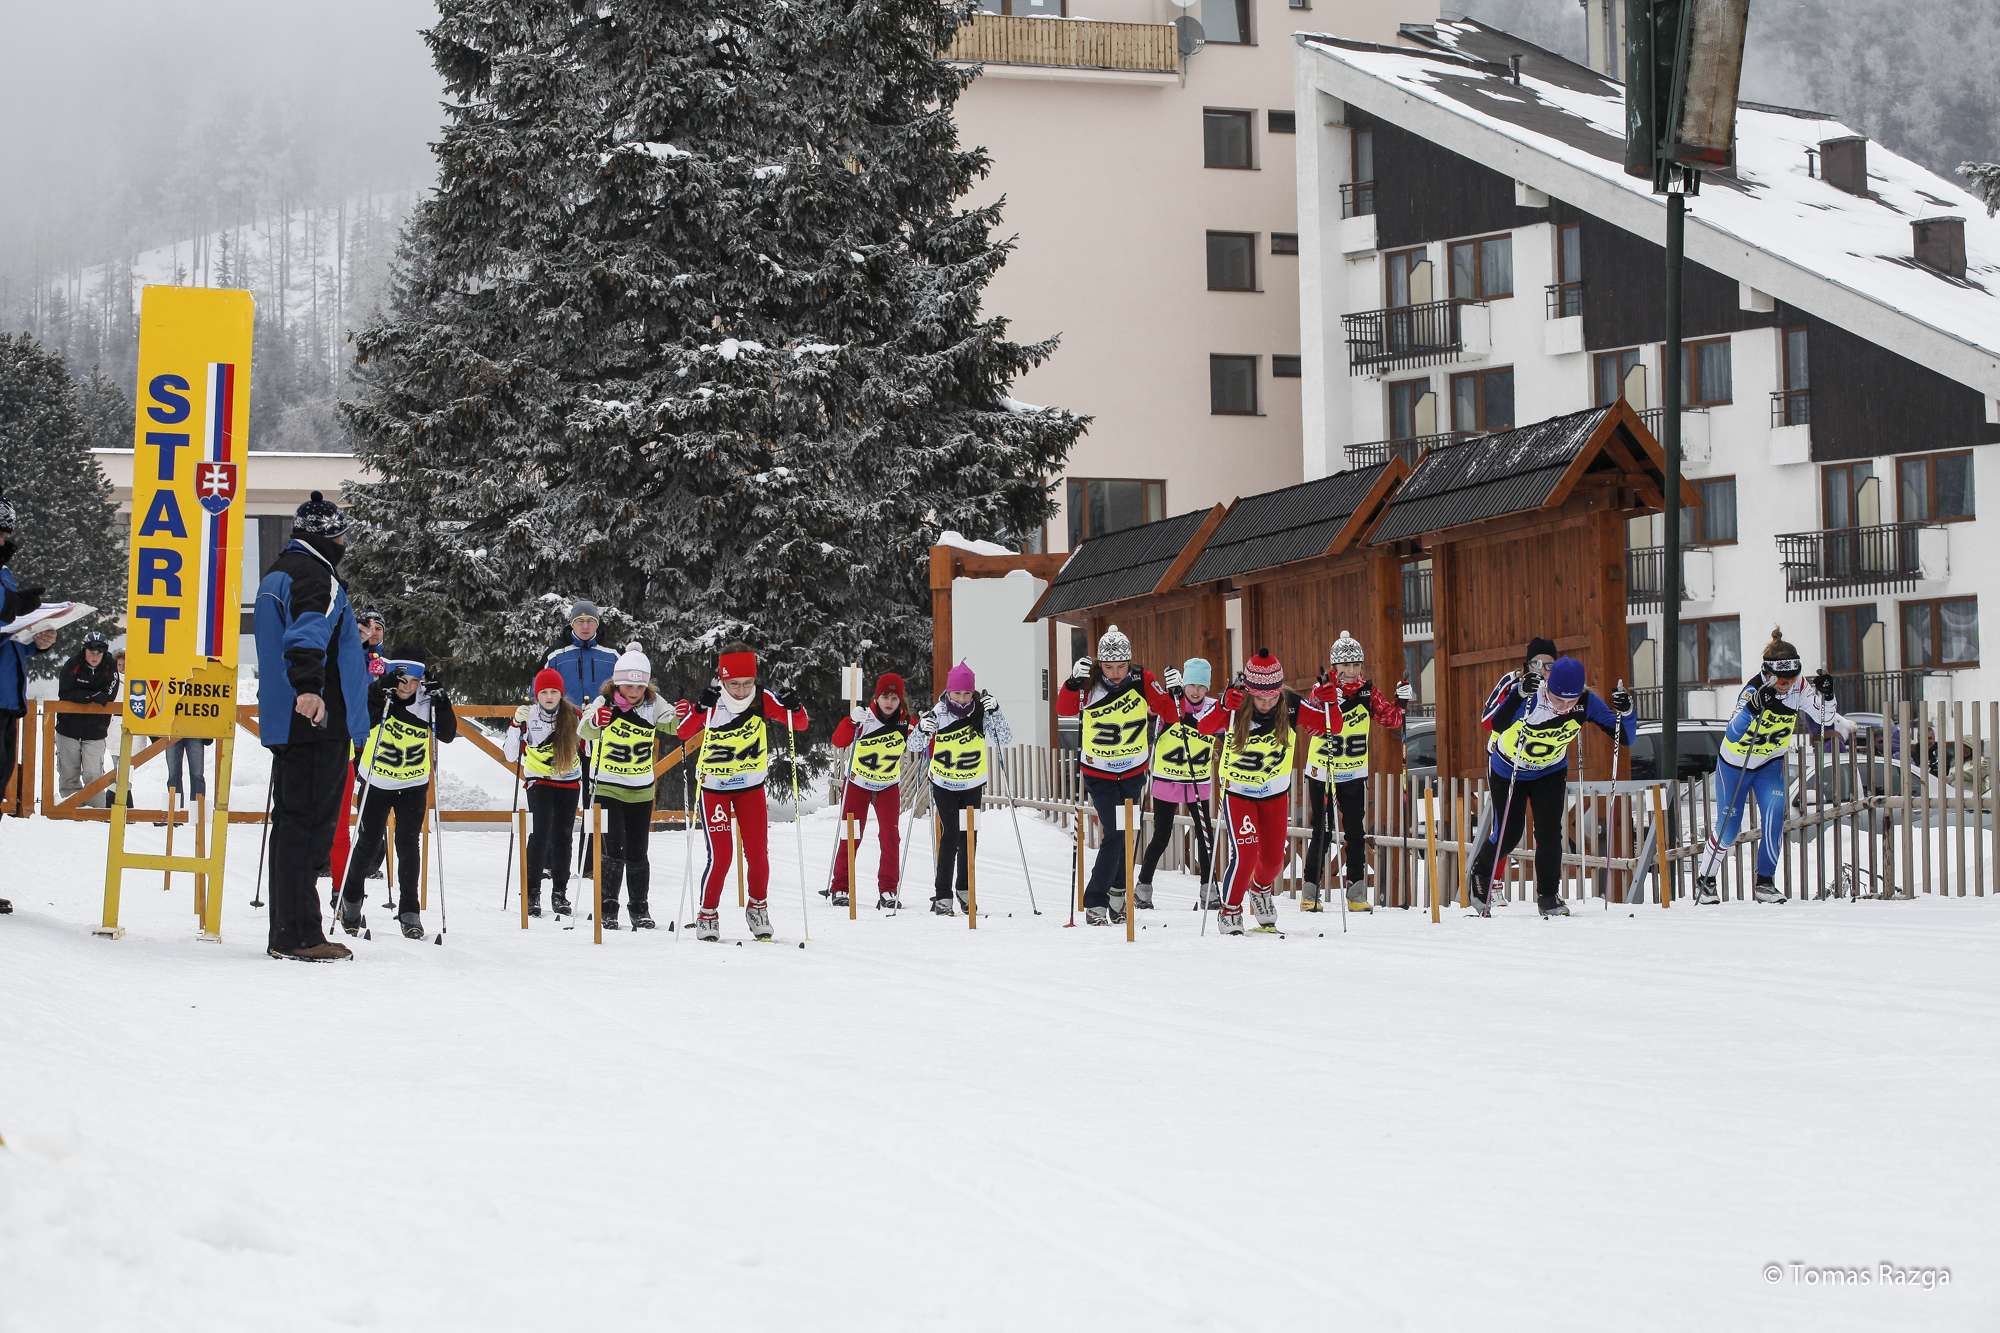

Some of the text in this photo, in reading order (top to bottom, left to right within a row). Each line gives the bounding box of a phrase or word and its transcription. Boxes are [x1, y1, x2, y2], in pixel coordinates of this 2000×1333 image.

[135, 374, 191, 655] START
[174, 703, 219, 717] PLESO
[1090, 694, 1132, 718] SLOVAK
[1121, 697, 1141, 714] CUP
[1348, 712, 1367, 727] CUP
[610, 726, 630, 739] CUP
[860, 734, 896, 747] SLOVAK
[1091, 719, 1146, 746] 37
[605, 741, 651, 764] 39
[703, 738, 766, 763] 34
[885, 738, 904, 749] CUP
[377, 742, 426, 768] 35
[858, 752, 900, 773] 47
[933, 750, 981, 770] 42
[1161, 746, 1211, 767] 44
